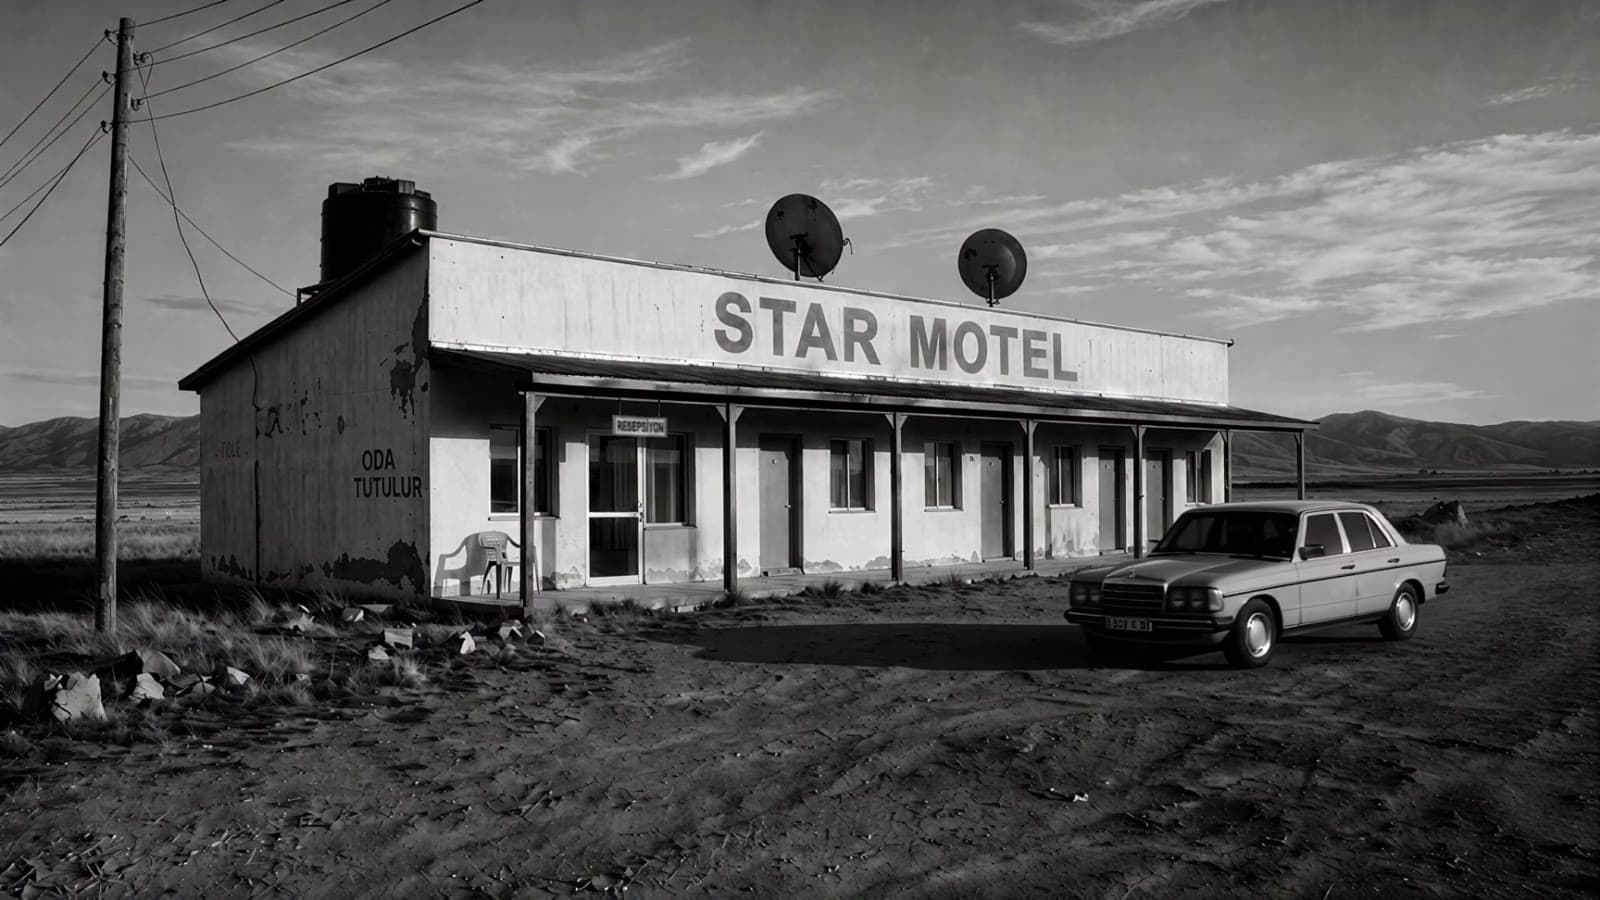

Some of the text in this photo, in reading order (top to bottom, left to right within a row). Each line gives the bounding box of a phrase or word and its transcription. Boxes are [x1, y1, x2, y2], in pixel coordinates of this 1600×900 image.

[714, 291, 1078, 382] STAR MOTEL
[362, 448, 396, 471] ODA
[353, 476, 423, 498] TUTULUR
